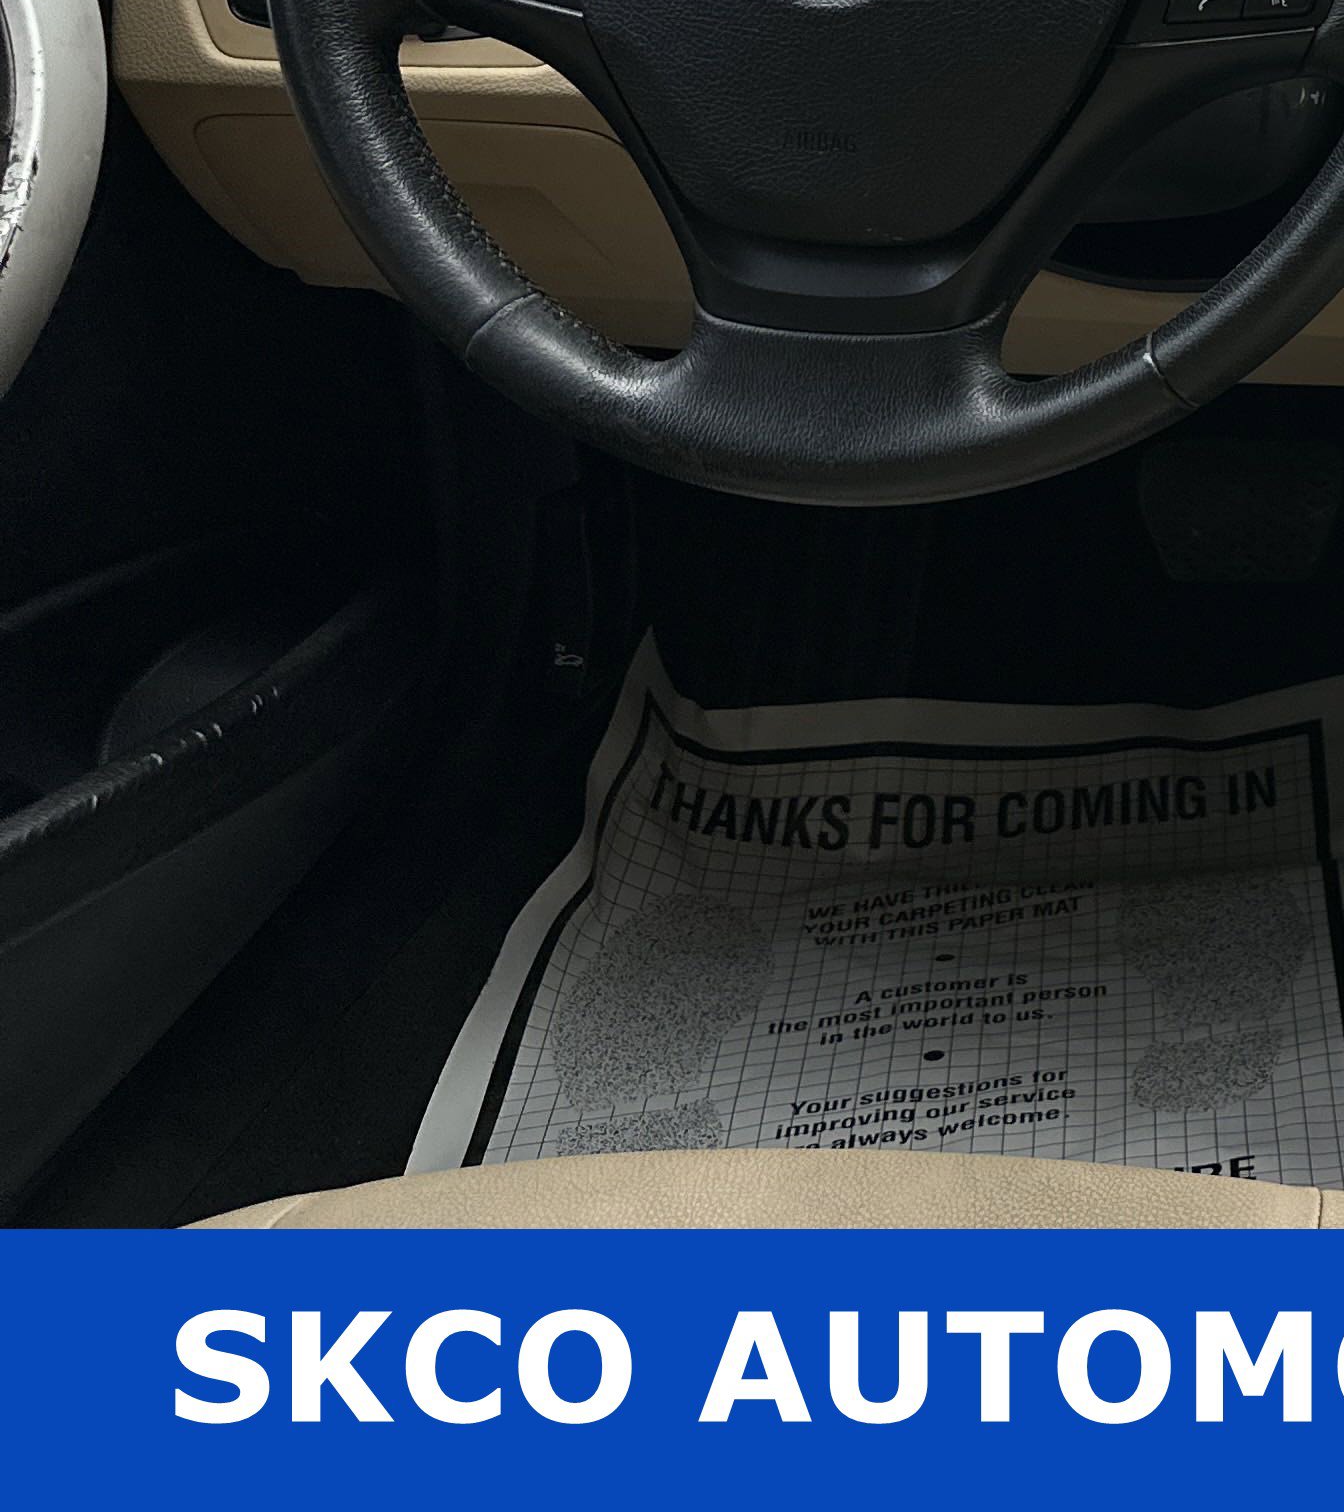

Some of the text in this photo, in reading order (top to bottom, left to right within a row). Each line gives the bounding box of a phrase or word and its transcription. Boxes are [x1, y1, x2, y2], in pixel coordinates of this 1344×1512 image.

[650, 761, 1278, 850] THANKS FOR COMING IN
[802, 915, 870, 934] YOUR
[879, 889, 1011, 926] CARPETING
[809, 903, 846, 919] WE
[852, 889, 914, 914] HAVE
[814, 895, 1083, 947] WITH THIS PAPER MAT
[768, 983, 1107, 1035] the most important person
[855, 972, 1027, 1004] A customer is
[820, 1008, 1054, 1046] in the world to us.
[775, 1087, 1077, 1140] improving our service
[789, 1068, 1069, 1116] Your suggestions for
[831, 1105, 1071, 1149] always welcome.
